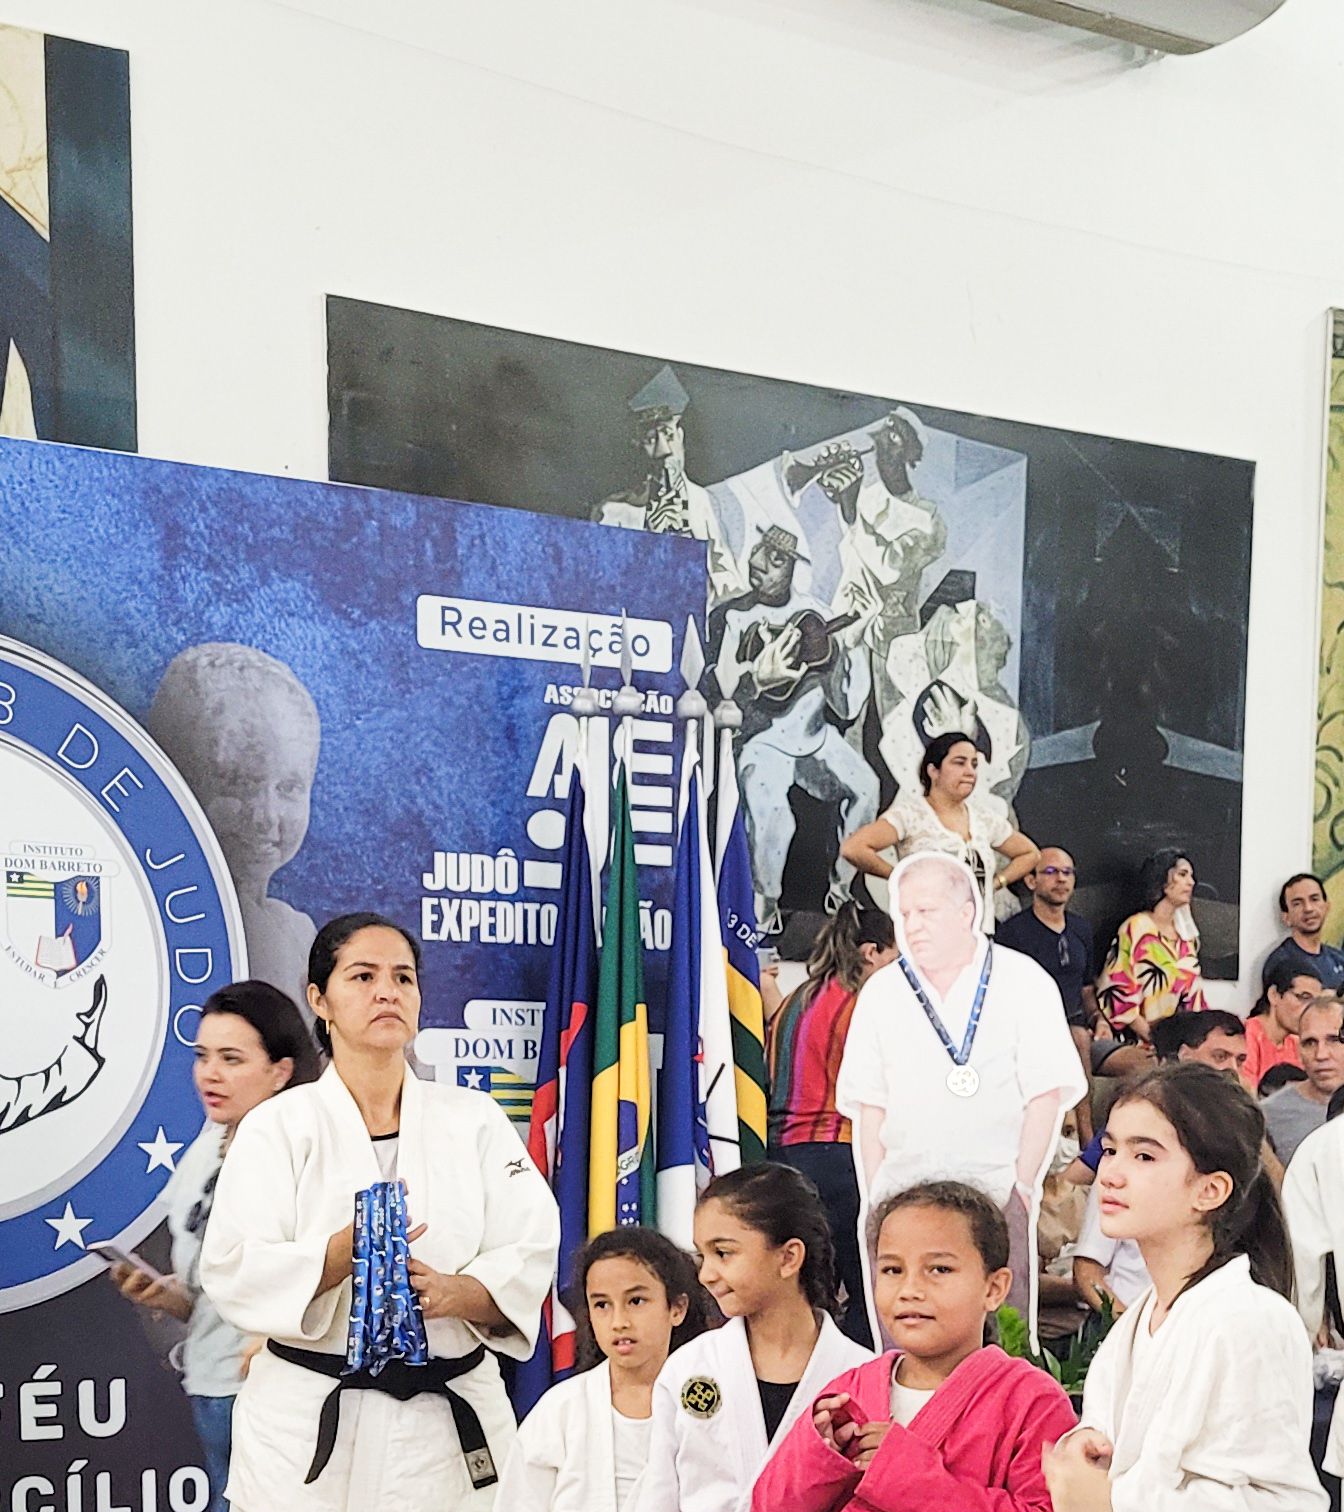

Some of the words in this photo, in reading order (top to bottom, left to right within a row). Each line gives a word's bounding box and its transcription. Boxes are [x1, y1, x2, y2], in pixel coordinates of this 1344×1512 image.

[440, 604, 650, 658] Realização
[56, 722, 145, 814] DE
[5, 857, 35, 869] DOM
[40, 859, 103, 873] BARRETO
[23, 844, 83, 856] INSTITUTO
[423, 848, 518, 894] JUDÔ
[422, 897, 558, 945] EXPEDITO
[455, 1038, 514, 1059] DOM
